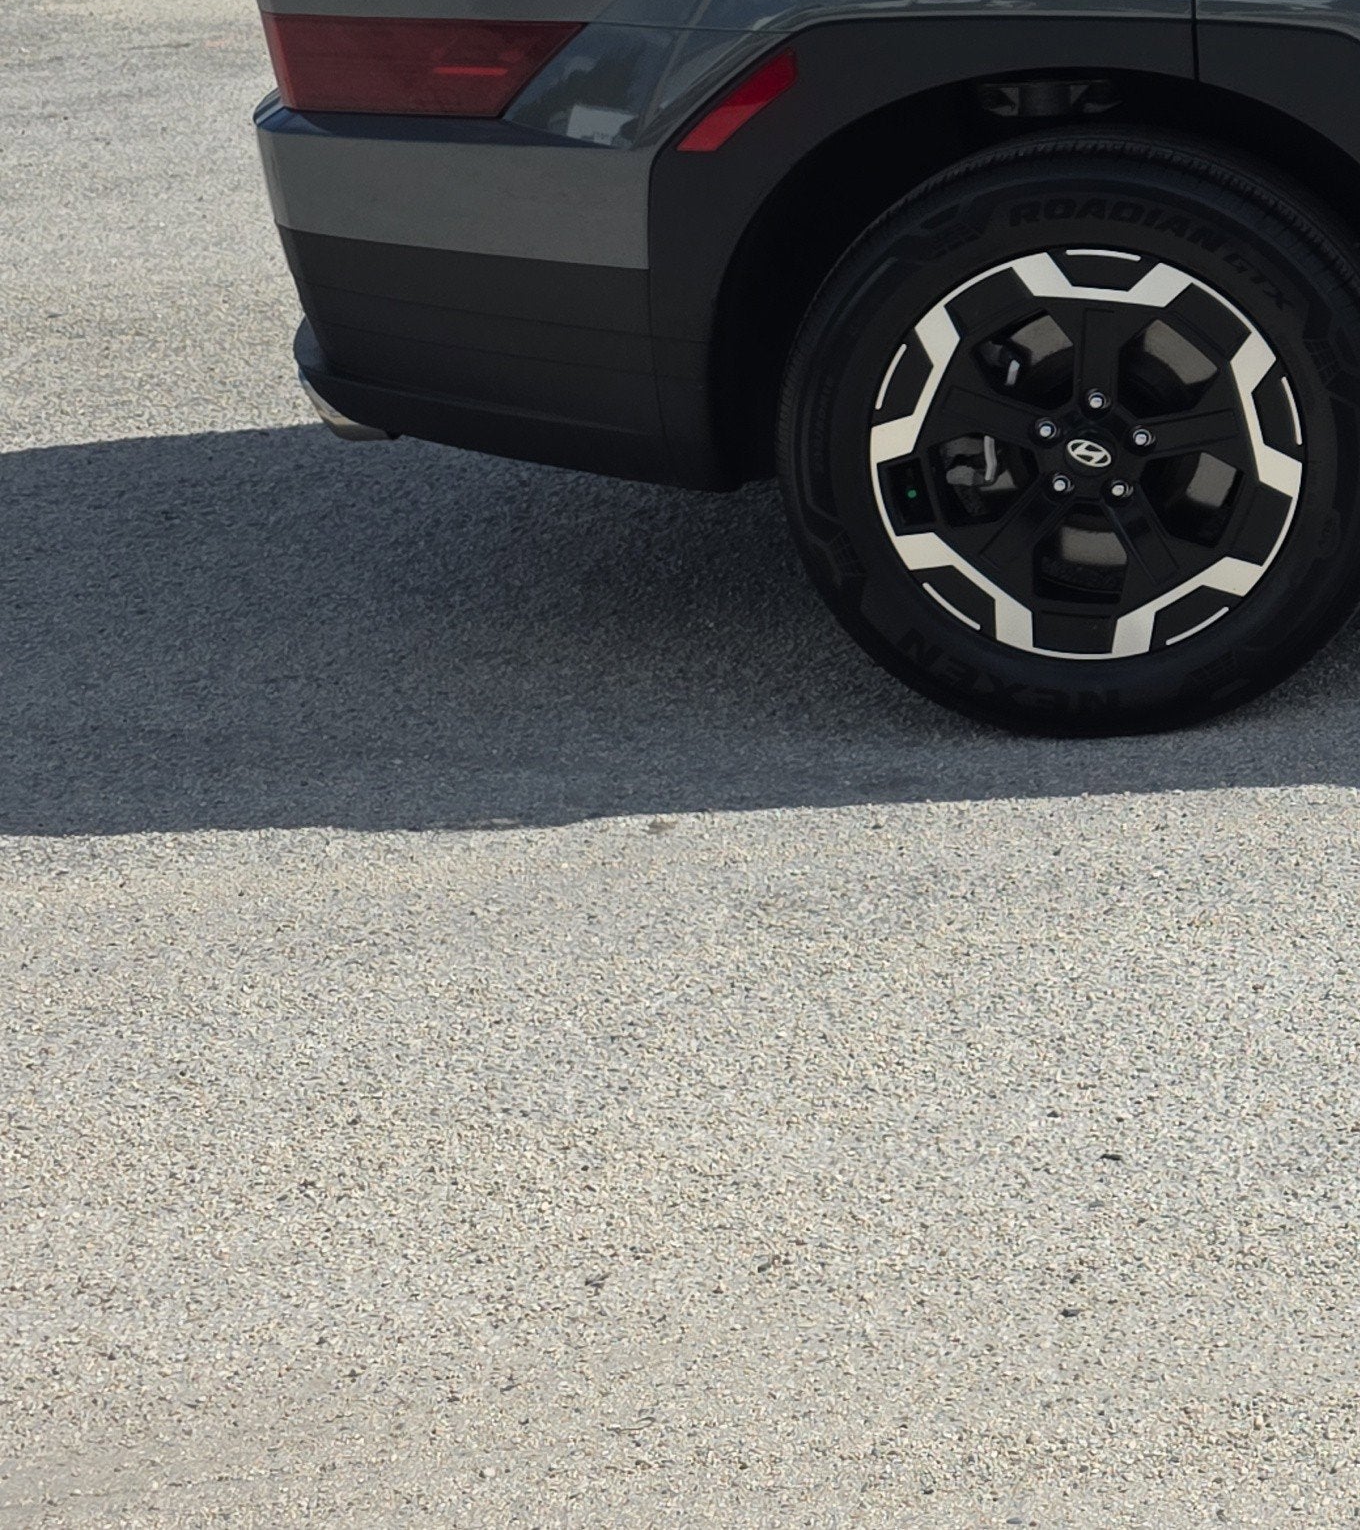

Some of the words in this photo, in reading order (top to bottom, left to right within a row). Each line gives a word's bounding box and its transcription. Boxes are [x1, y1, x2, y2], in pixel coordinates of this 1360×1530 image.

[1008, 196, 1229, 254] ROADIAN
[1222, 247, 1294, 311] GTX
[894, 626, 1121, 716] NEXEN
